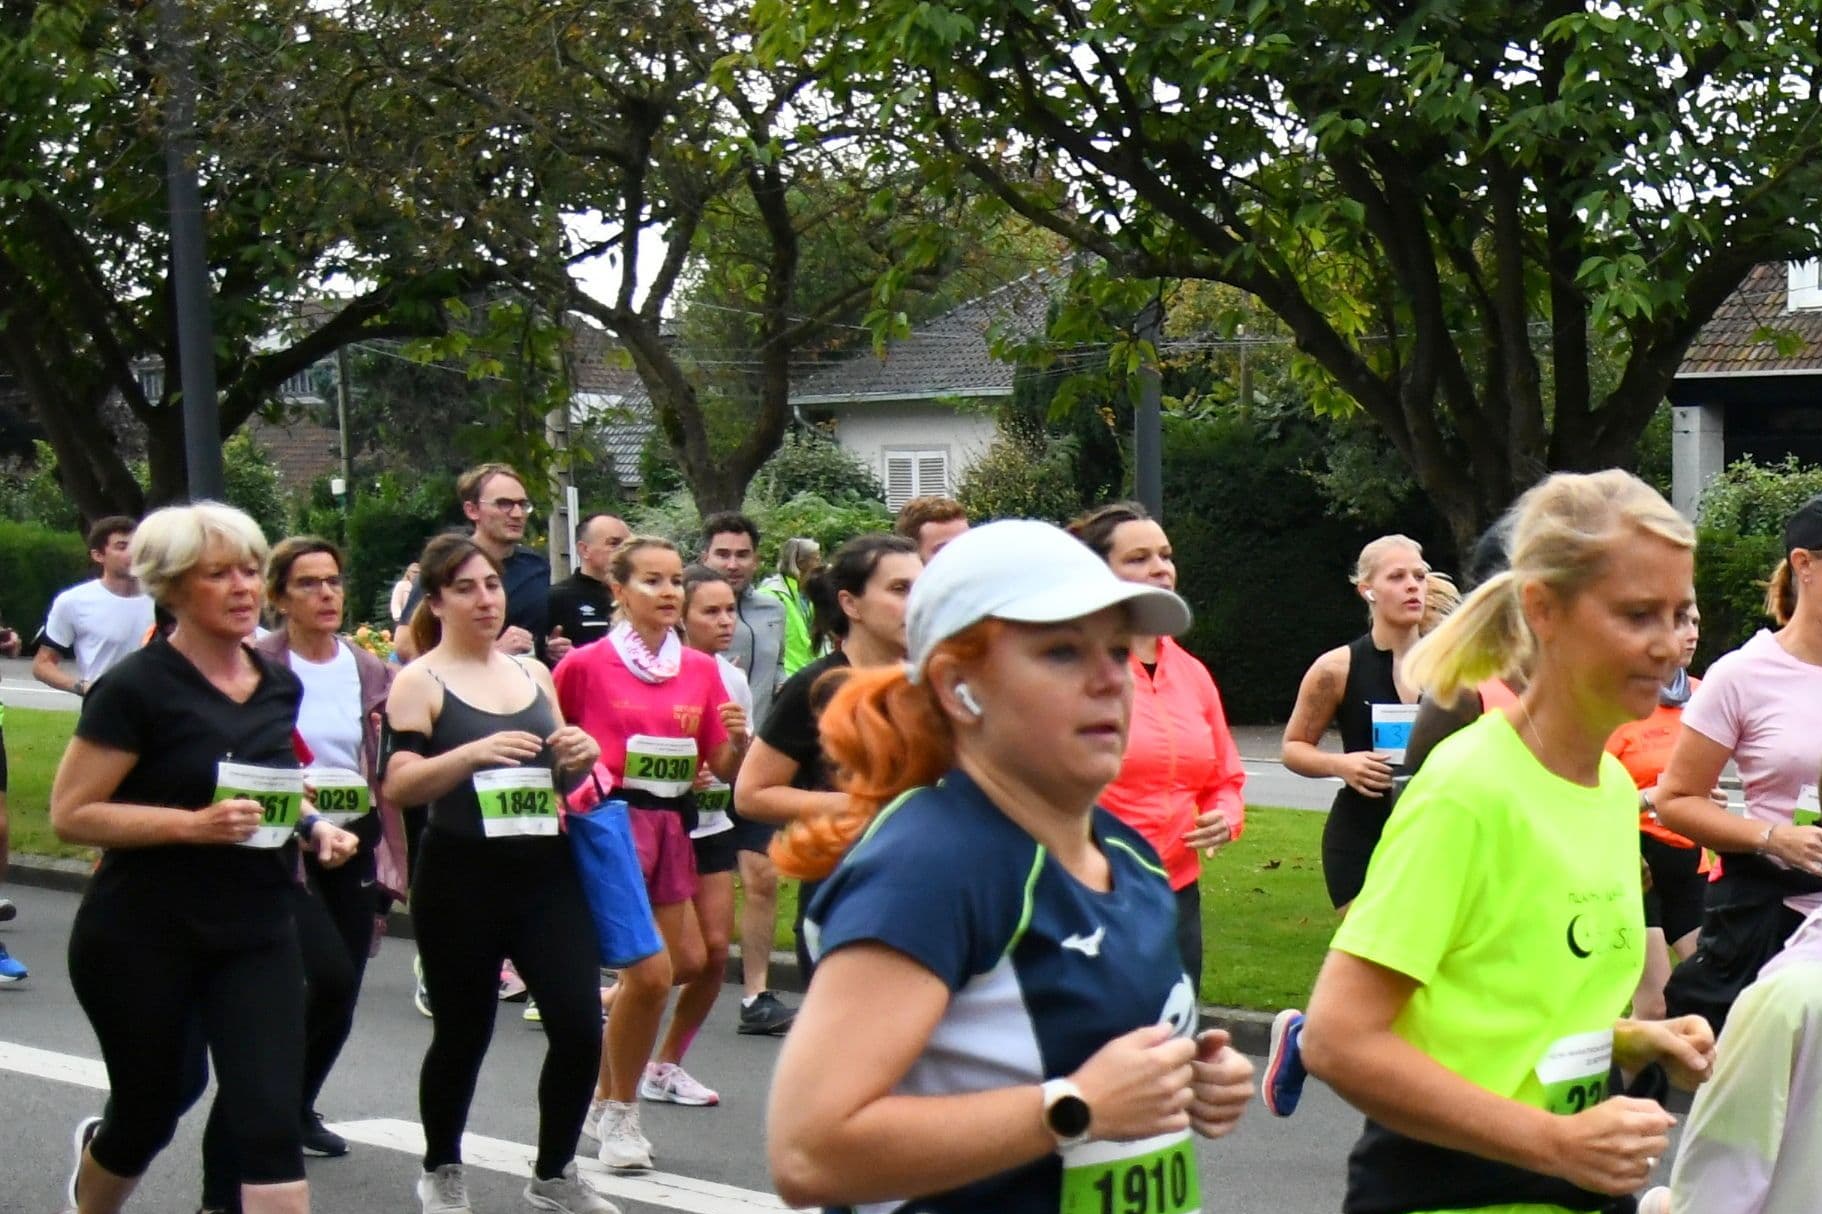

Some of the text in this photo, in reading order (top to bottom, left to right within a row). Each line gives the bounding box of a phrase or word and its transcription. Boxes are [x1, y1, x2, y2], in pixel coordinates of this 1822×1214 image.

[637, 755, 690, 780] 2030
[311, 788, 360, 812] 029
[495, 790, 550, 815] 1842
